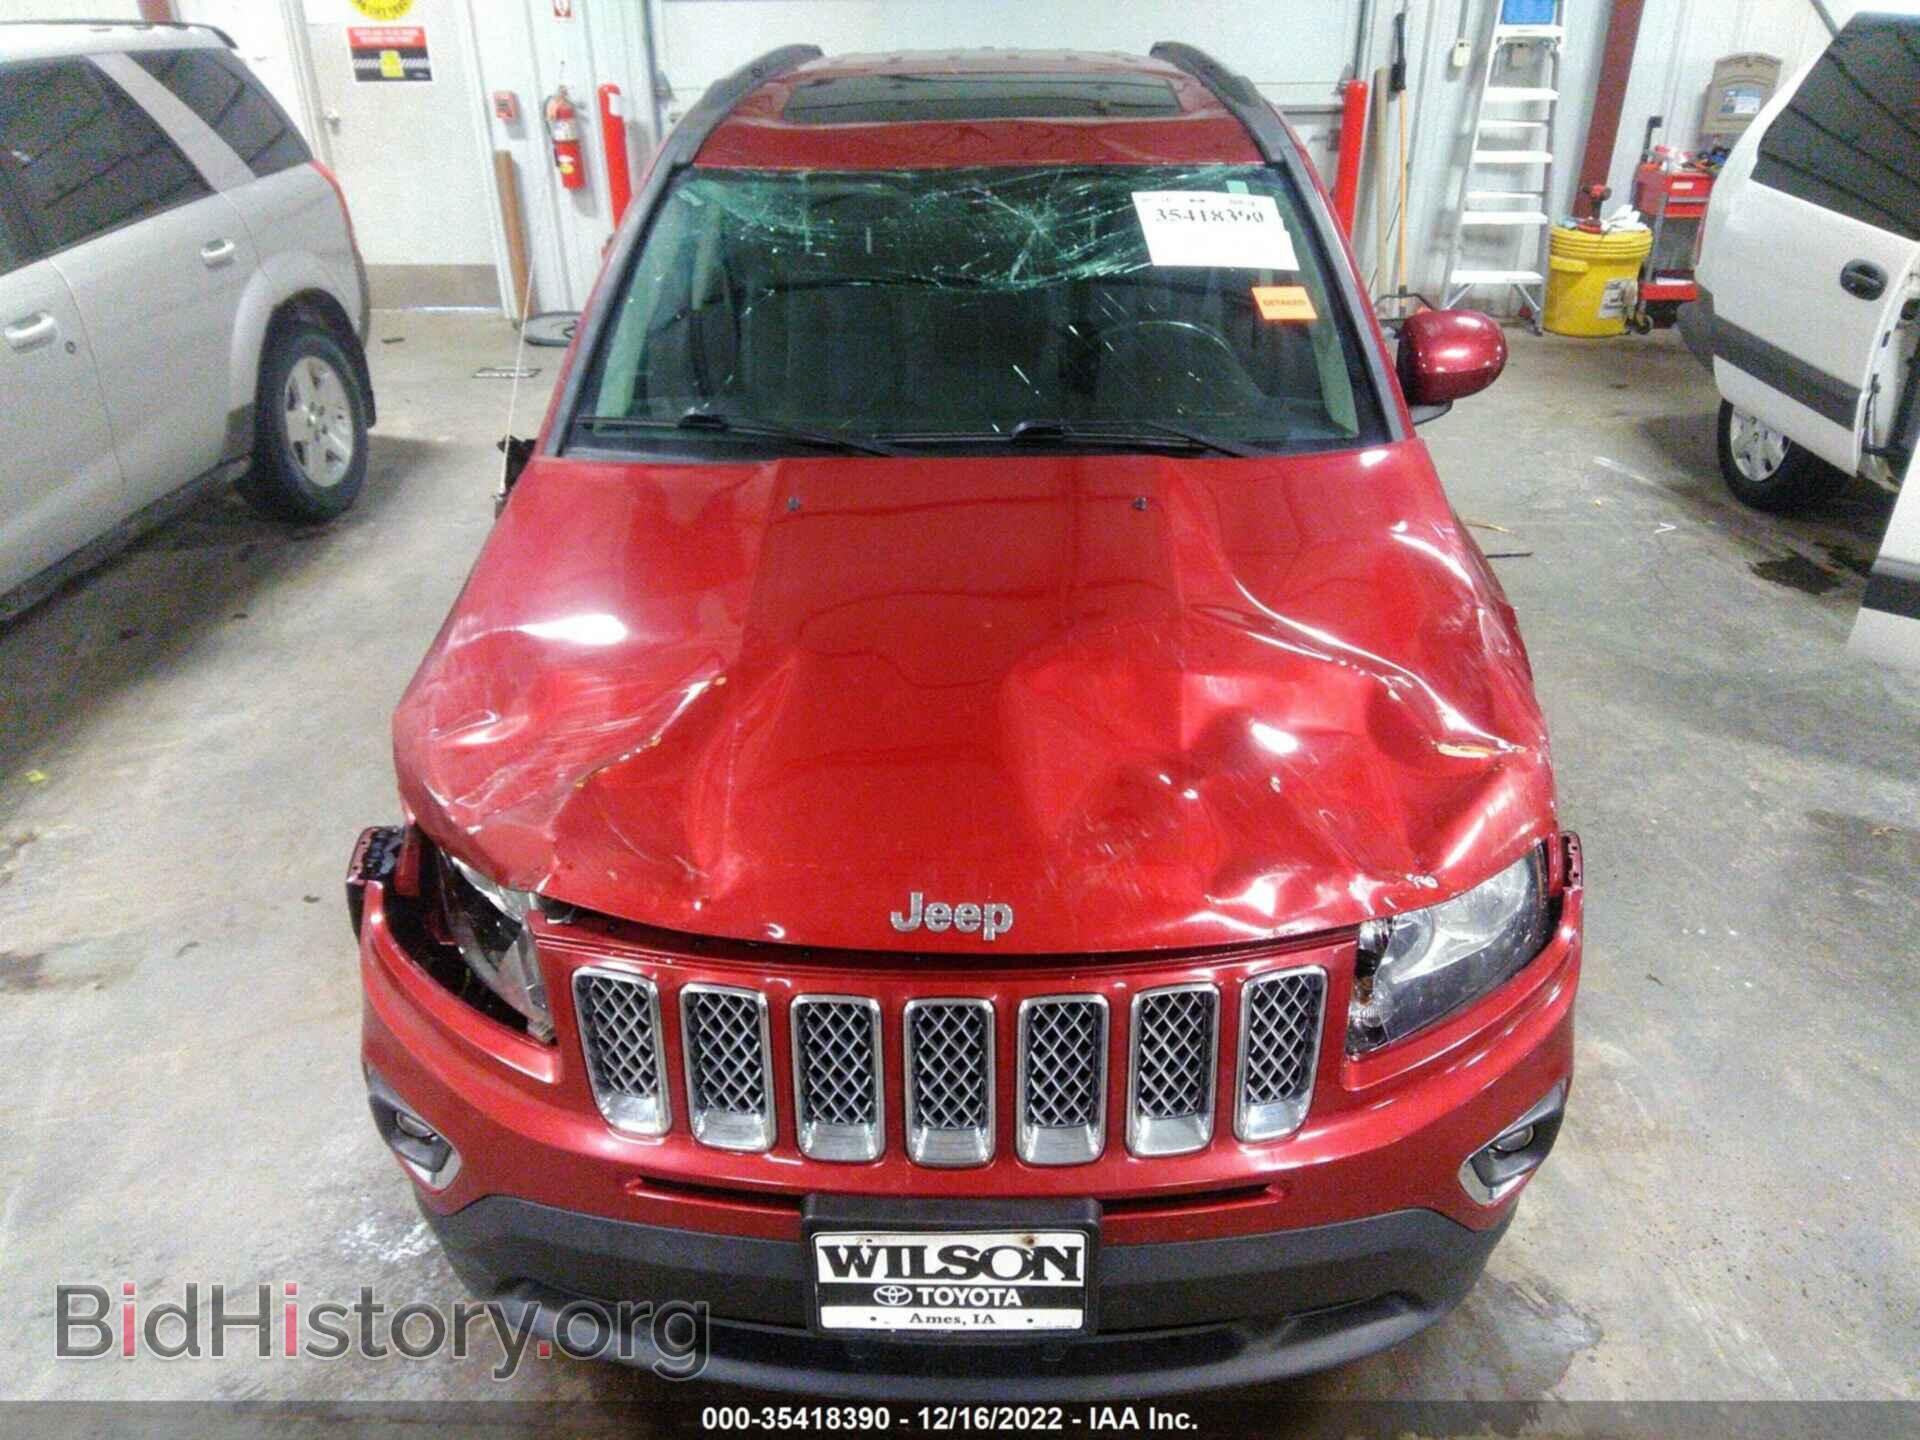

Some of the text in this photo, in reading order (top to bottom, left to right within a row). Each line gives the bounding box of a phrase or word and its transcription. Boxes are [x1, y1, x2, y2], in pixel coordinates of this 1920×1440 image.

[889, 891, 1014, 941] Jeep
[818, 1244, 1083, 1282] WILSON
[916, 1286, 1023, 1307] TOYOTA
[908, 1312, 996, 1326] Ames, IA
